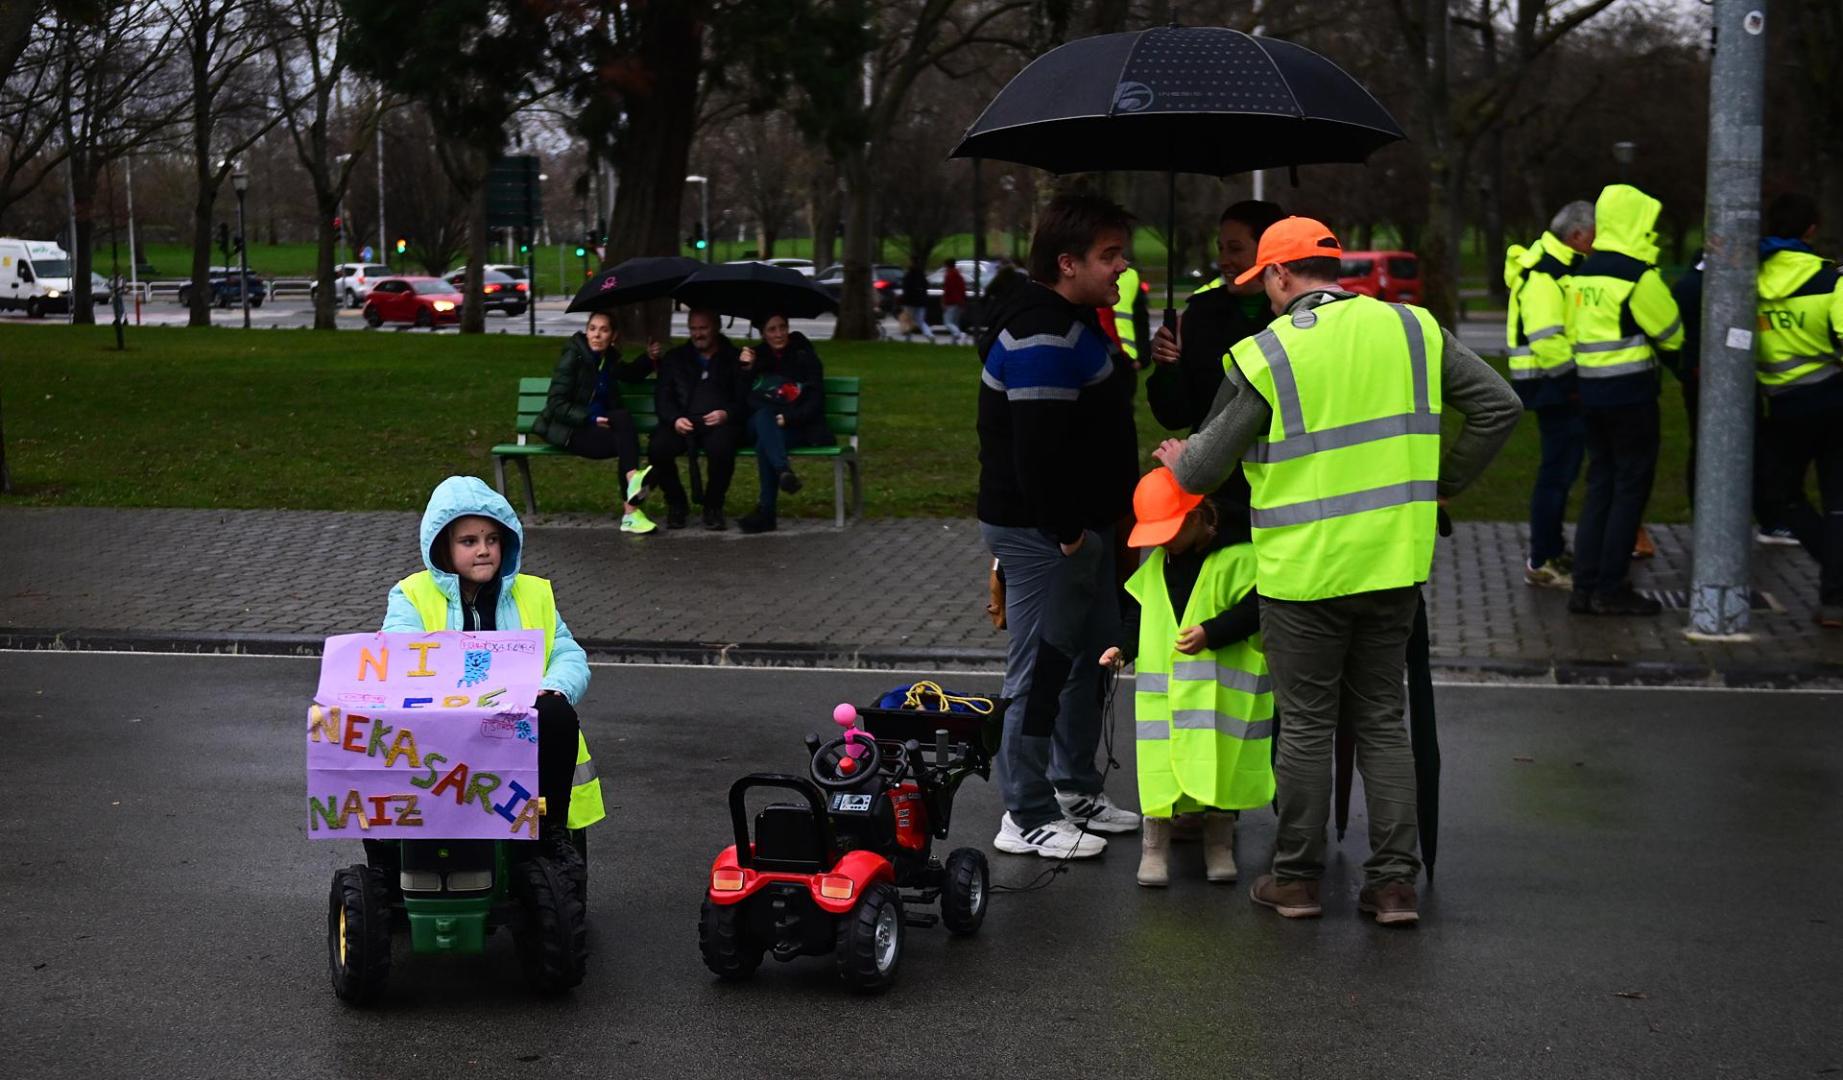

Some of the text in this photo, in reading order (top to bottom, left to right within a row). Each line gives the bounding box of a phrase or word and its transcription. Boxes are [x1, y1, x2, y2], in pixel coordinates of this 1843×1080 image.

[1762, 310, 1805, 329] TBV
[358, 642, 441, 681] NI
[310, 705, 547, 838] NEKASARIA
[310, 790, 423, 831] NAIZ
